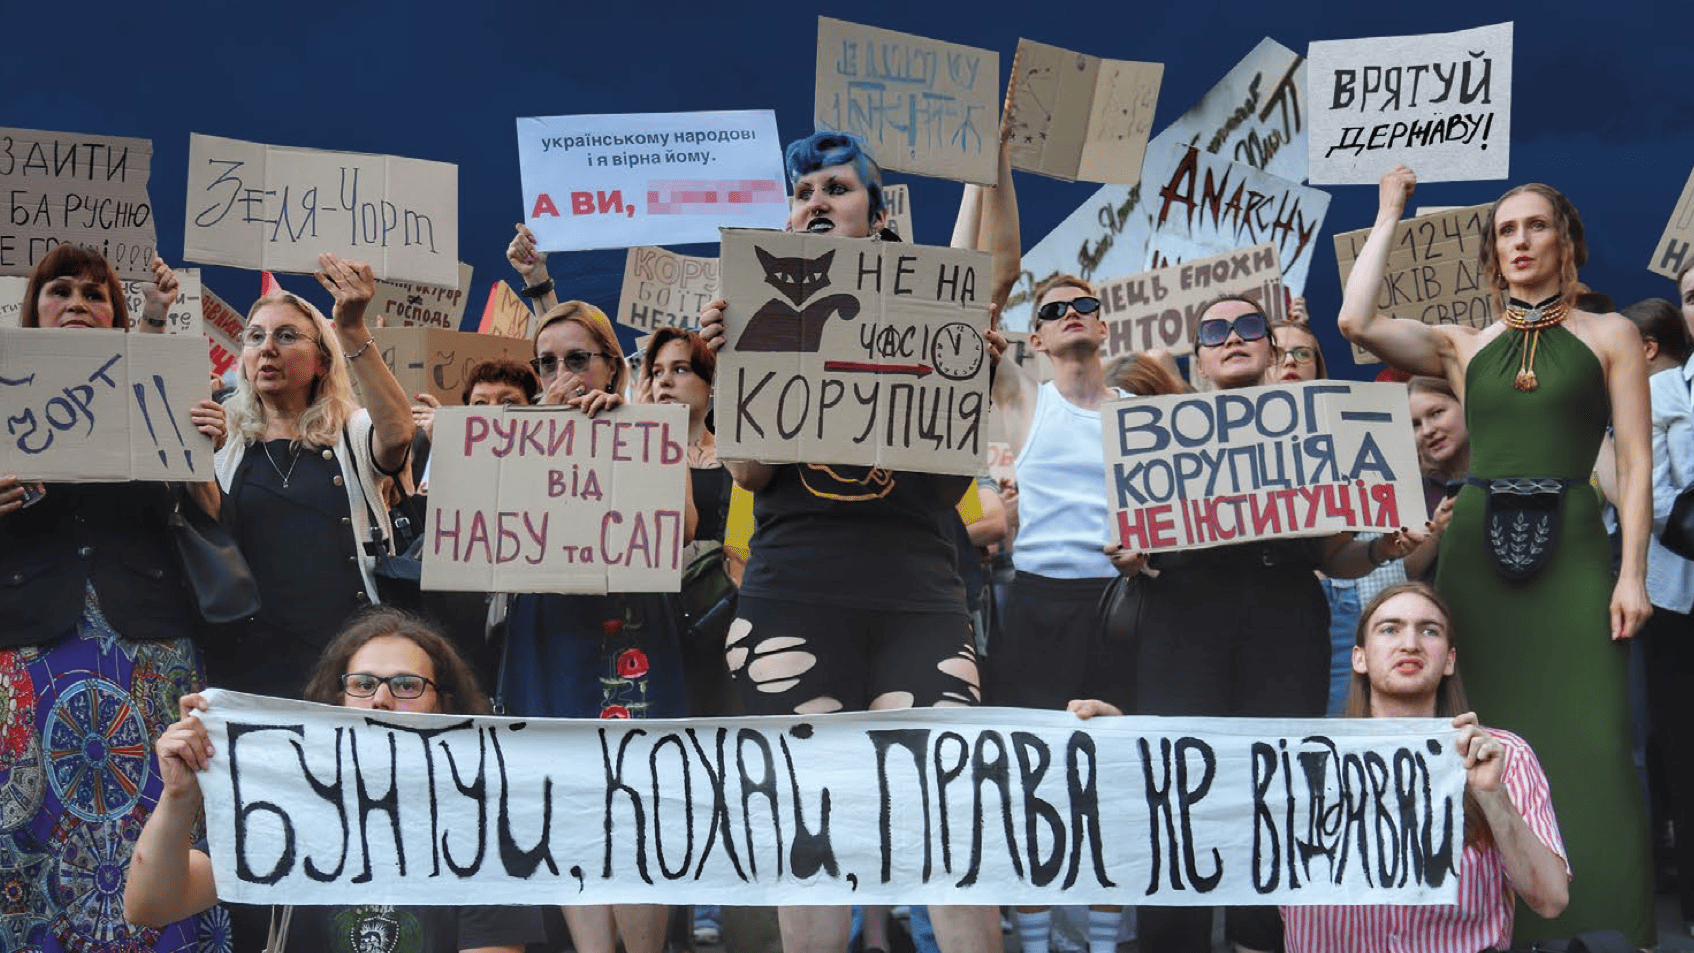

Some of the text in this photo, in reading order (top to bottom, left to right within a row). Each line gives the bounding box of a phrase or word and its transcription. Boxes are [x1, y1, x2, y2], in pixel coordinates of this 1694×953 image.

[1328, 50, 1492, 113] ВРЯТУЙ
[541, 129, 756, 152] українському народові
[597, 155, 608, 167] я
[613, 152, 661, 168] вірна
[665, 150, 716, 165] йому.
[1325, 112, 1494, 158] ДЕРЖАВУ!
[531, 193, 560, 218] А
[571, 190, 635, 218] ВИ,
[1157, 131, 1317, 275] ANARCHY
[857, 251, 917, 295] НЕ
[937, 264, 976, 308] НА
[1181, 247, 1274, 290] ЕПОХИ
[385, 299, 451, 328] ГОСПОДЬ
[736, 366, 983, 456] КОРУПЦІЯ
[1117, 386, 1351, 457] ВОРОГ
[464, 415, 684, 465] РУКИ ГЕТЬ
[1350, 431, 1397, 481] А
[434, 508, 549, 565] НАБУ
[600, 510, 681, 570] САП
[1116, 503, 1178, 550] НЕ
[227, 716, 586, 892] БУНТУЙ,
[598, 723, 858, 891] КОХАЙ,
[867, 728, 1116, 890] ПРАВА
[1137, 736, 1223, 895] НЕ
